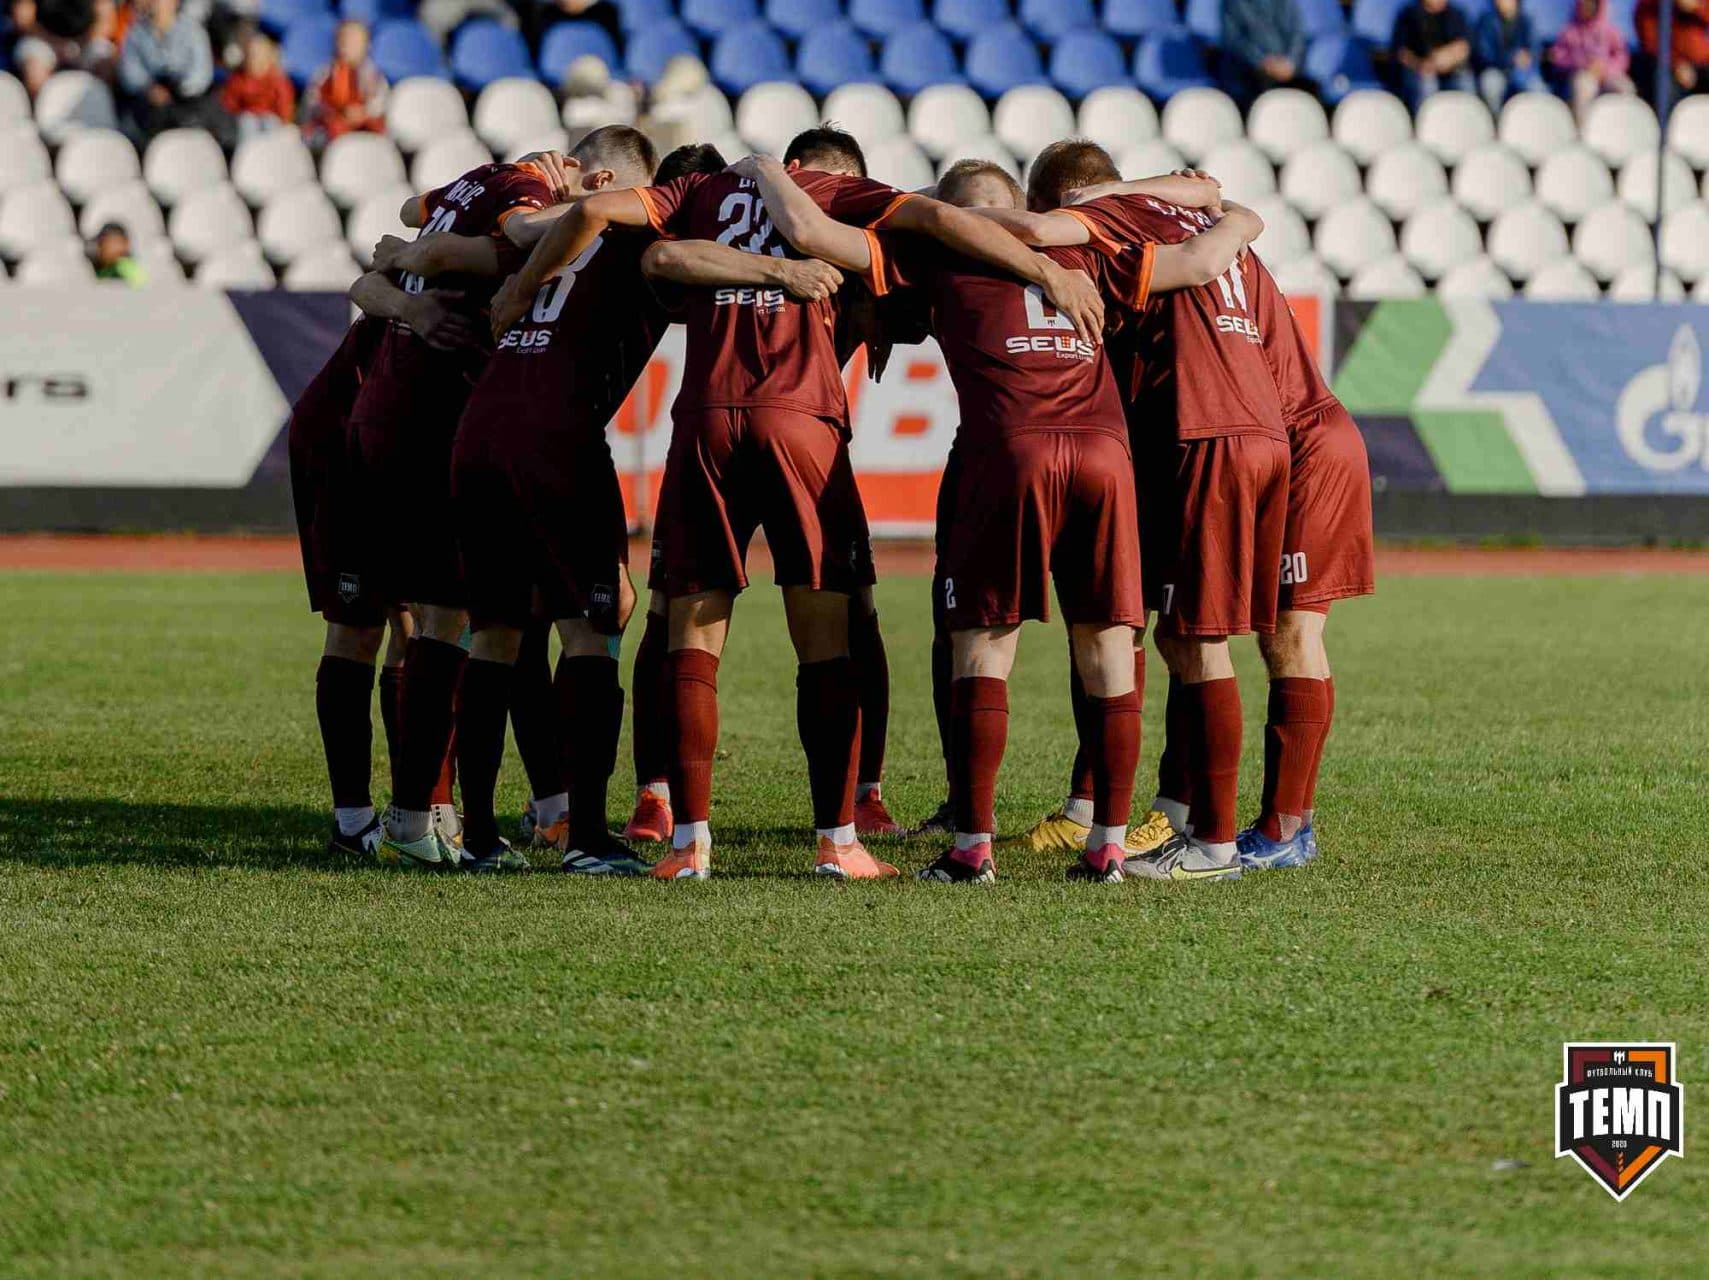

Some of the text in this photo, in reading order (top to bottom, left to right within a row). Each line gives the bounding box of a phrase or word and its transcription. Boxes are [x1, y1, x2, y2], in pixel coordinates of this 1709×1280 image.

[1216, 315, 1260, 338] SEU
[1005, 336, 1095, 357] SEUS
[1280, 552, 1308, 584] 20
[945, 577, 957, 608] 2
